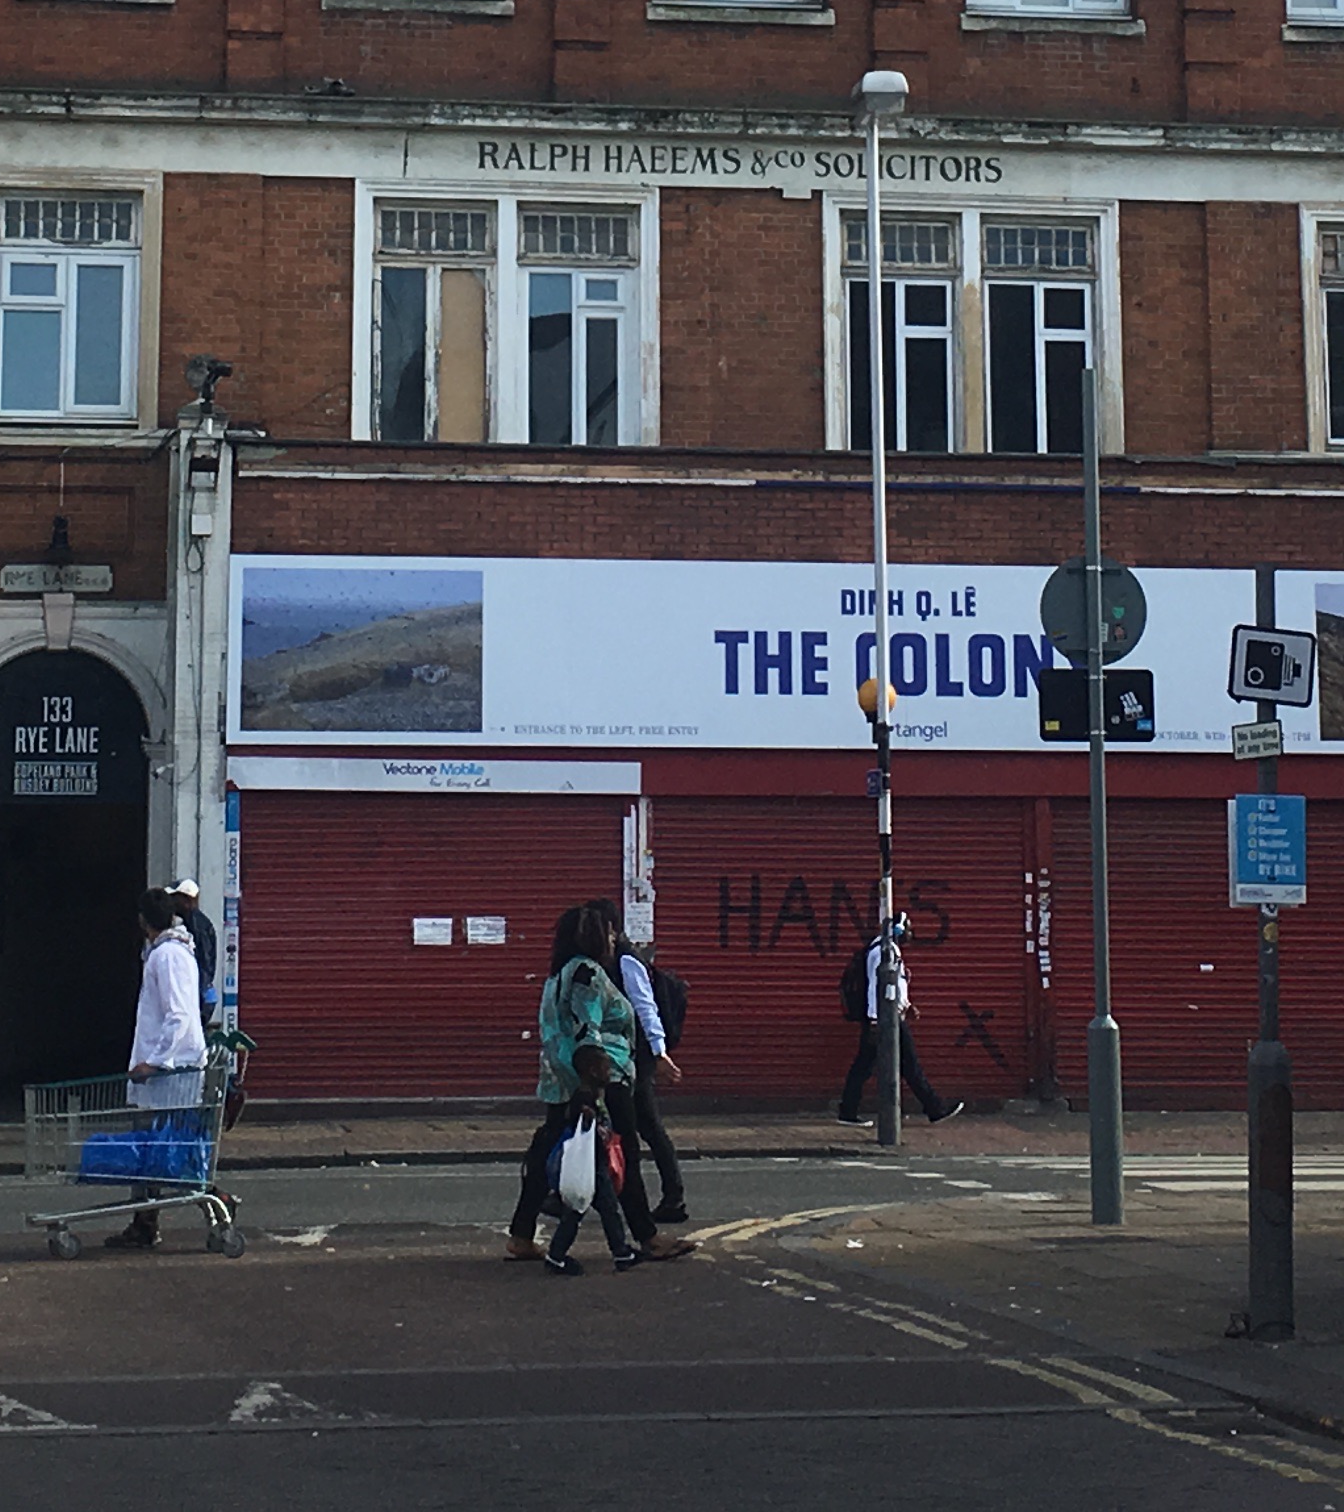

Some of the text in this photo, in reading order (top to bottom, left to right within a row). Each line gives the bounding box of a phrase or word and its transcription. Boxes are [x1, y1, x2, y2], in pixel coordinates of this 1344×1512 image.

[477, 140, 590, 173] RALPH
[603, 143, 741, 175] HAEEMS
[814, 149, 1003, 184] SOLICITORS
[42, 569, 83, 586] LANE
[916, 589, 941, 622] Q.
[714, 629, 1089, 698] THE COLON
[42, 696, 73, 723] 133
[513, 724, 567, 735] ENTRANCE
[570, 725, 583, 735] TO
[667, 726, 699, 735] ENTRY
[894, 721, 948, 743] tangel
[1237, 731, 1248, 741] No
[1249, 728, 1278, 740] loading
[15, 726, 100, 754] RYE LANE
[14, 764, 63, 779] COPELAND
[63, 764, 89, 779] PARK
[383, 762, 485, 776] Vectone Mobile
[52, 778, 98, 794] BUILDING
